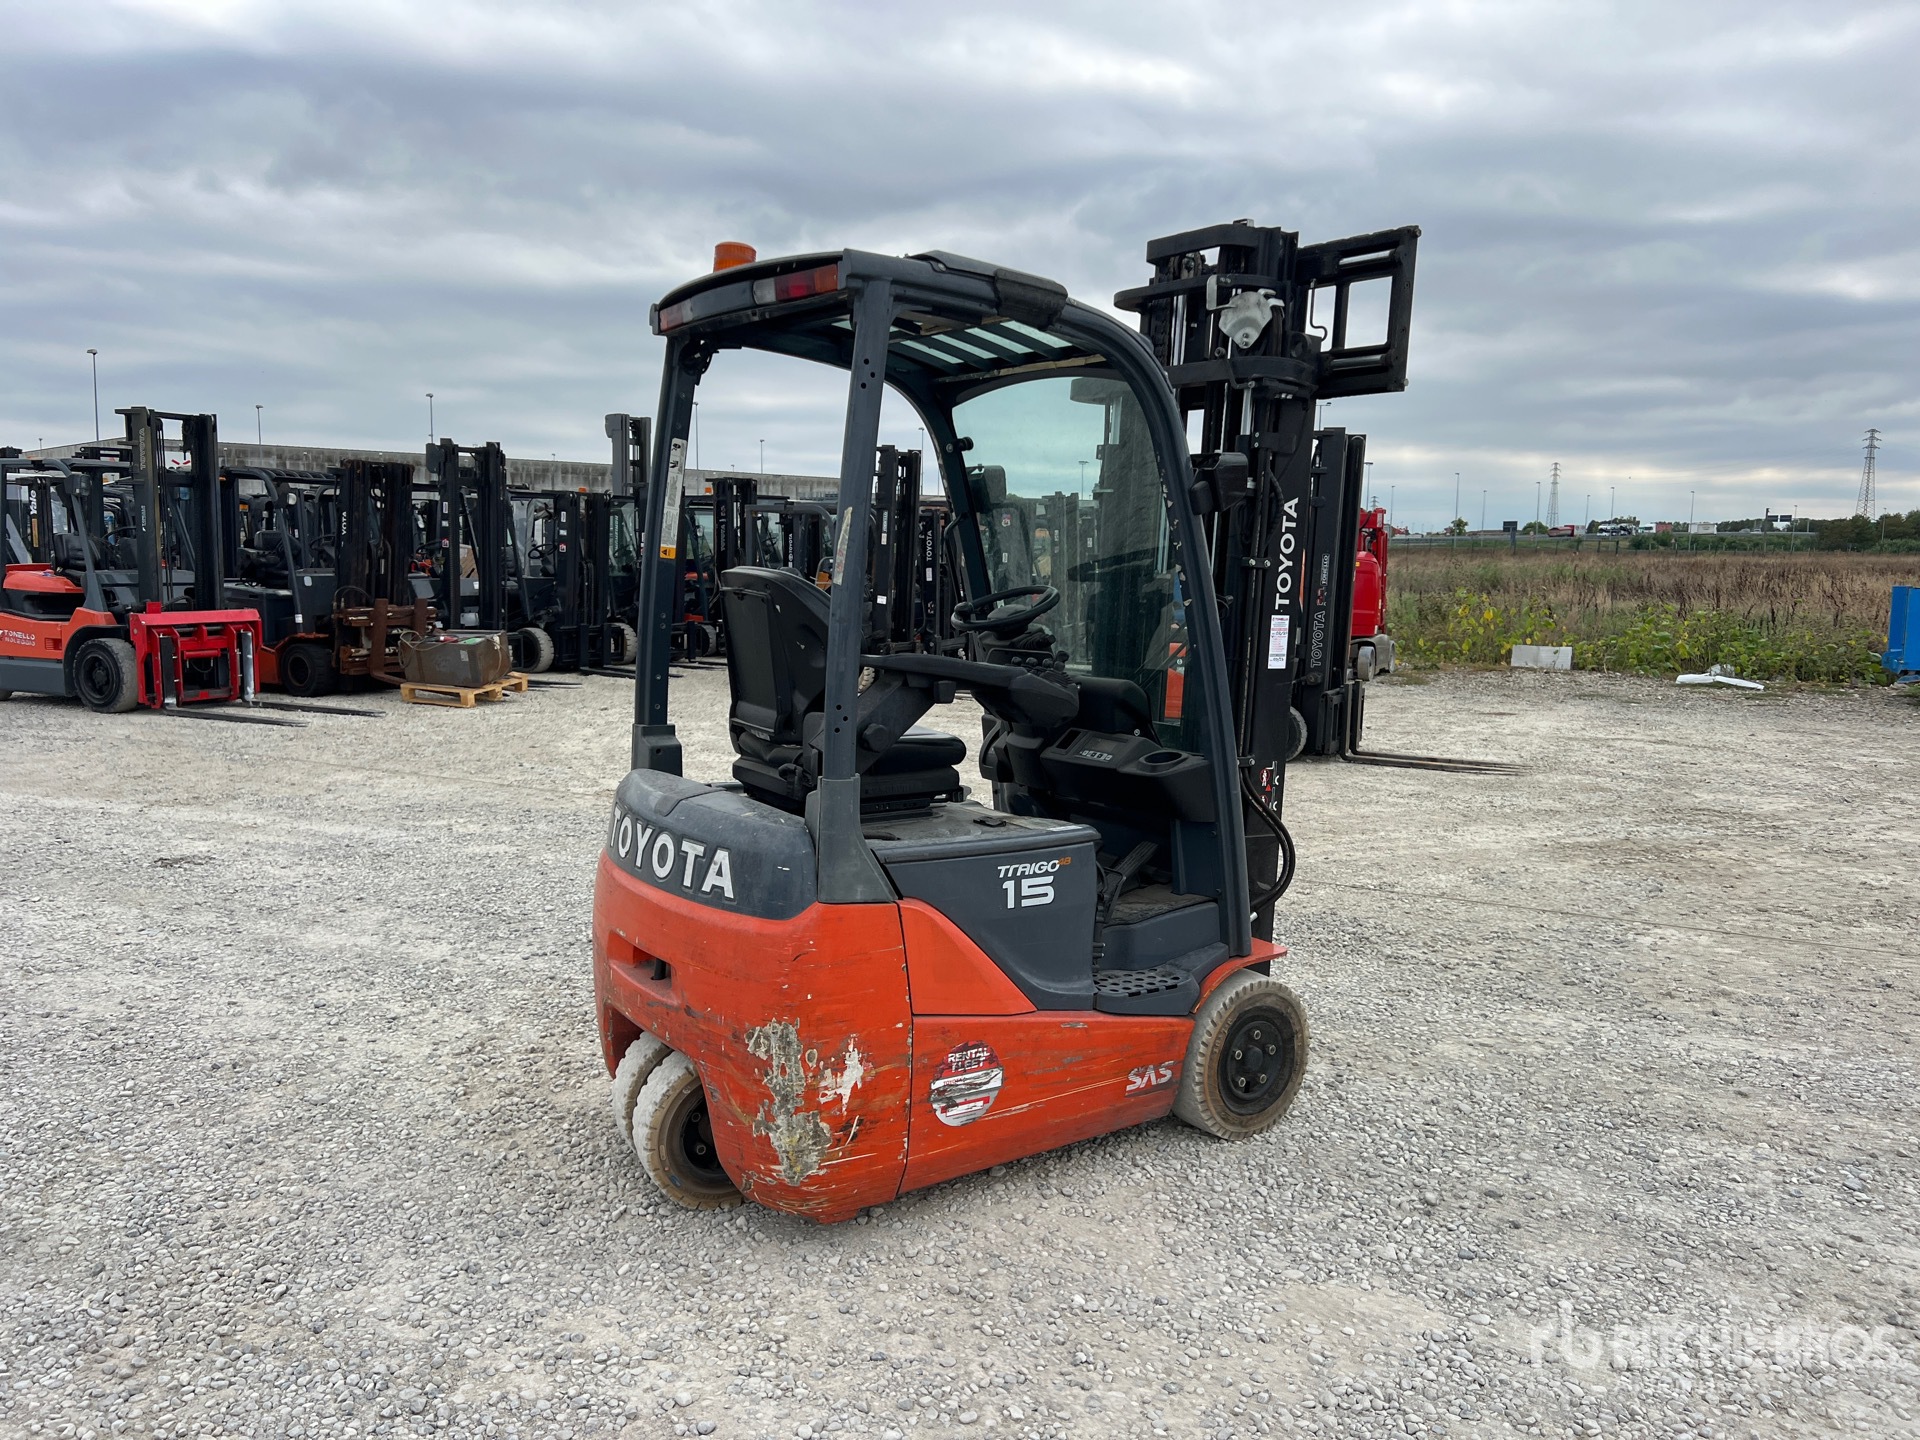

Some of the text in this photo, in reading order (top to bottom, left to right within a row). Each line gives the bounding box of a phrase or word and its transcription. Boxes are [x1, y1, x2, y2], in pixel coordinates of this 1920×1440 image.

[1274, 497, 1299, 610] TOYOTA
[3, 630, 36, 640] TONELLO
[1311, 611, 1326, 668] TOYOTA
[610, 806, 735, 899] TOYOTA
[1002, 875, 1055, 909] 15
[947, 1047, 991, 1064] RENTAL
[951, 1057, 987, 1073] FLEET
[1125, 1060, 1175, 1092] SAS
